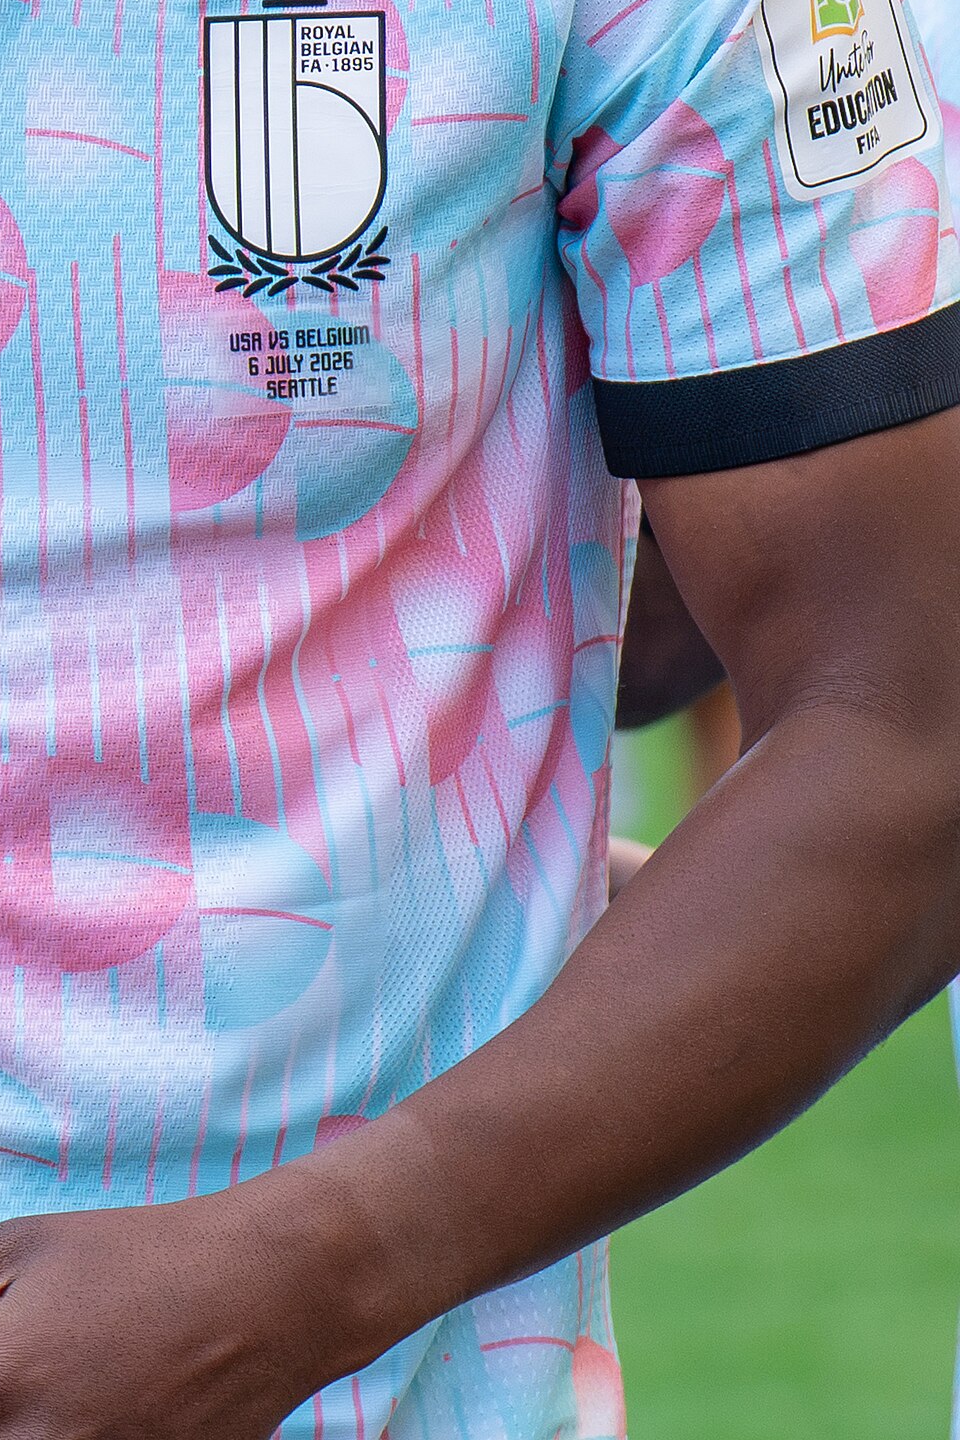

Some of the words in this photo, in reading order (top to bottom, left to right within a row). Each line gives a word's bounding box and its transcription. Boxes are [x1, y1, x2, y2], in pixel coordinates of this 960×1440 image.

[301, 25, 355, 40] ROYAL
[301, 41, 374, 57] BELGIAN
[856, 125, 881, 155] FIFA
[229, 332, 262, 352] USA
[268, 330, 290, 350] VS
[295, 325, 370, 349] BELGIUM
[248, 357, 259, 376] 6
[265, 354, 304, 375] JULY
[310, 351, 354, 372] 2026
[266, 376, 338, 400] SEATTLE
